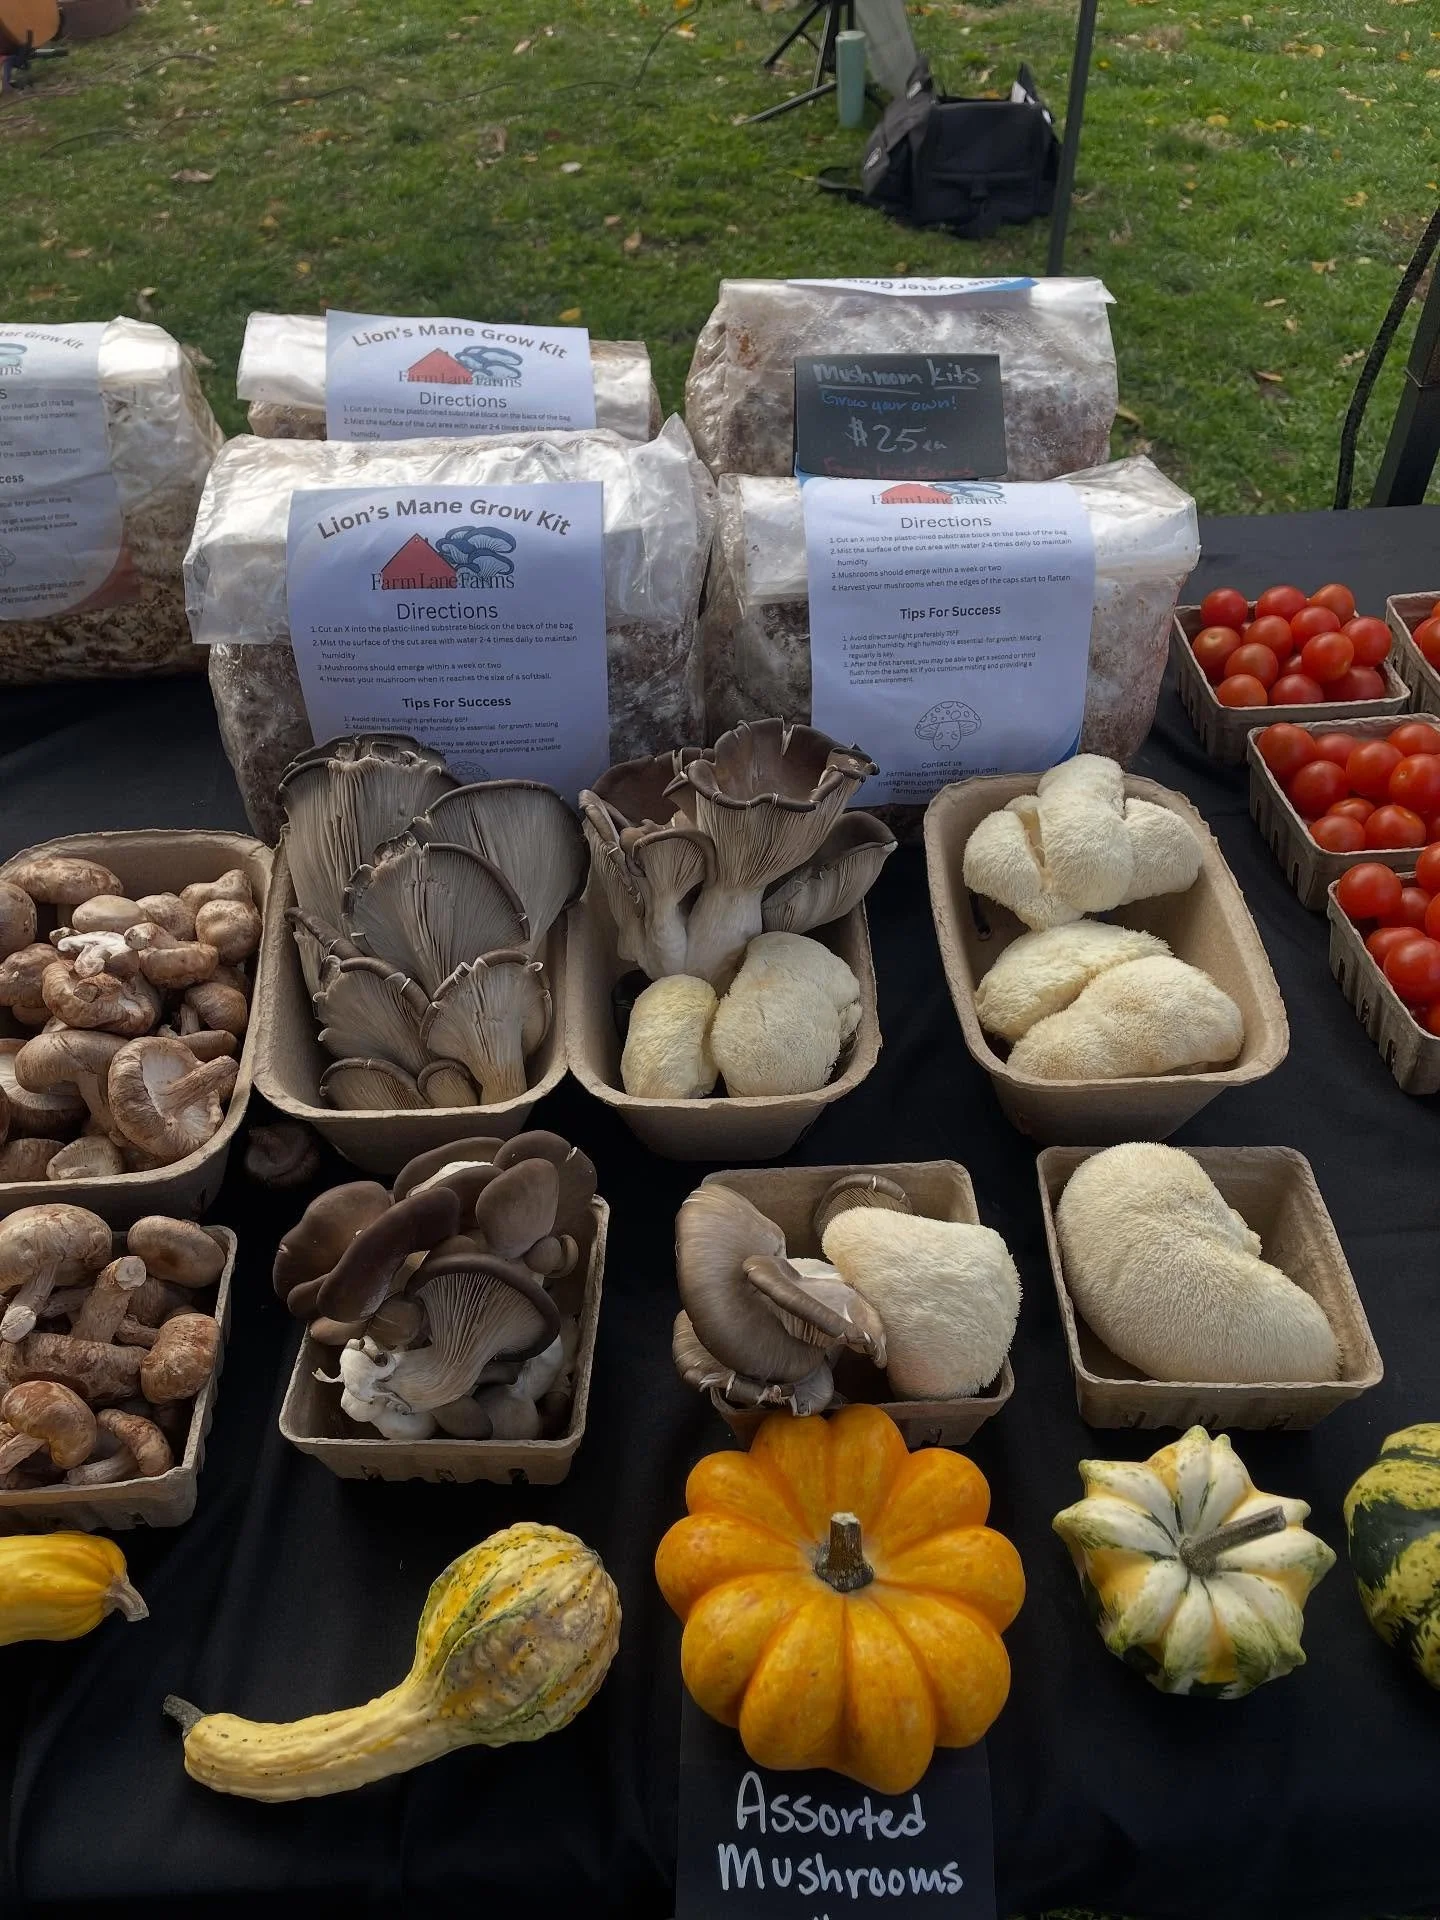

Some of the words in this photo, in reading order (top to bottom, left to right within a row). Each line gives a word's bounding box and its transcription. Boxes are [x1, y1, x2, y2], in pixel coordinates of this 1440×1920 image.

[63, 338, 84, 350] Kit
[352, 327, 412, 346] Lion's
[418, 324, 474, 336] Mane
[481, 329, 535, 348] Grow
[538, 341, 568, 359] Kit
[399, 370, 438, 383] Farm
[440, 372, 472, 385] Lane
[475, 376, 522, 388] Farms
[420, 392, 507, 408] Directions
[821, 390, 867, 408] Grow
[871, 401, 907, 414] your
[911, 395, 957, 411] own!
[871, 494, 917, 505] Farm
[918, 494, 952, 504] Lane
[953, 494, 1007, 505] Farms
[318, 505, 389, 539] Lion's
[396, 499, 462, 516] Mane
[470, 499, 534, 522] Grow
[536, 510, 571, 536] Kit
[900, 515, 992, 529] Directions
[1014, 540, 1030, 548] daily
[837, 559, 868, 567] humidity
[838, 570, 878, 578] Mushrooms
[988, 564, 1002, 572] two
[371, 573, 416, 590] Farm
[420, 572, 457, 589] Lane
[459, 572, 515, 590] Farms
[838, 584, 866, 592] Harvest
[866, 584, 882, 592] your
[884, 582, 925, 590] mushrooms
[1002, 577, 1019, 585] caps
[396, 602, 498, 620] Directions
[900, 608, 926, 620] Tips
[929, 608, 950, 618] For
[952, 606, 1001, 617] Success
[383, 624, 430, 633] plastic-lined
[432, 624, 468, 632] substrate
[560, 622, 574, 630] bag
[392, 638, 404, 646] the
[480, 636, 492, 644] 2-4
[494, 636, 514, 644] times
[516, 636, 533, 644] daily
[322, 652, 356, 660] humidity
[446, 674, 476, 682] reaches
[522, 672, 552, 680] softball.
[402, 698, 430, 710] Tips
[433, 698, 455, 708] For
[458, 697, 512, 708] Success
[922, 760, 951, 769] Contact
[736, 1770, 926, 1841] Assorted
[717, 1842, 963, 1899] Mushrooms
